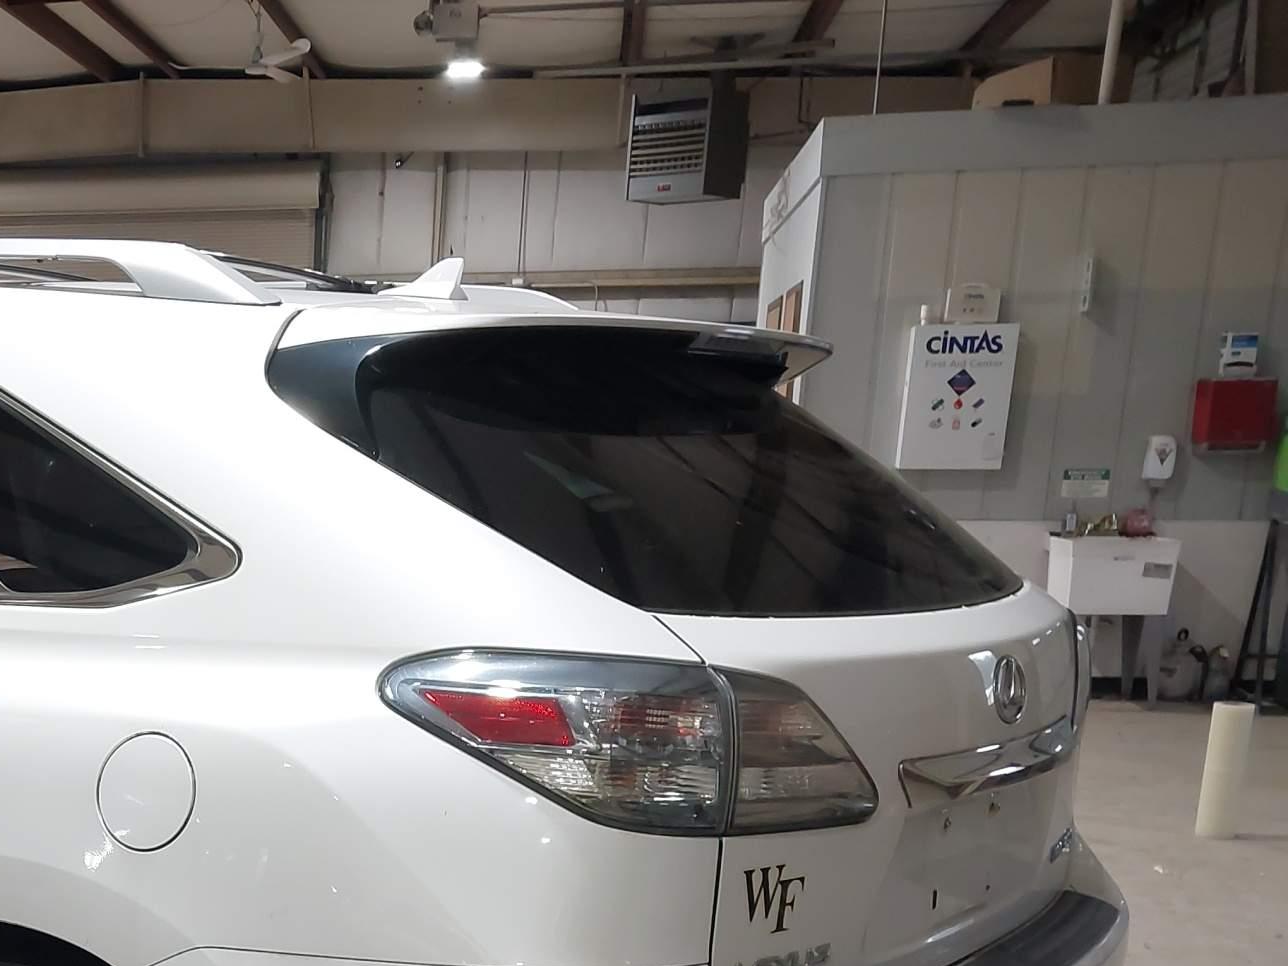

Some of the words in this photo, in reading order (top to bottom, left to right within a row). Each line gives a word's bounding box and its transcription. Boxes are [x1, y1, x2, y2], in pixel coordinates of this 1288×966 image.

[925, 359, 946, 368] First
[950, 359, 967, 368] Aid
[970, 359, 1003, 369] Center
[744, 864, 805, 934] WF
